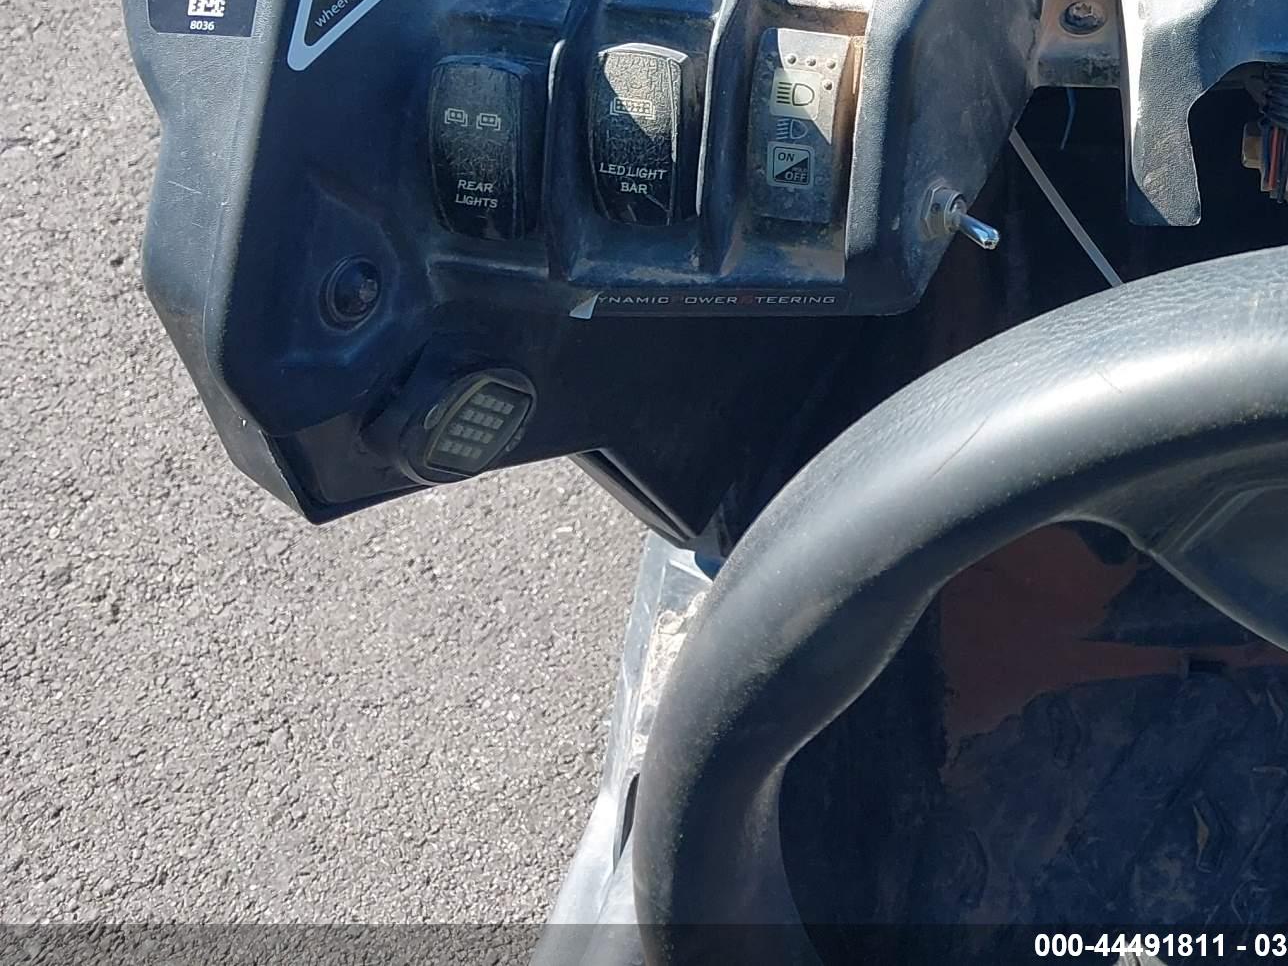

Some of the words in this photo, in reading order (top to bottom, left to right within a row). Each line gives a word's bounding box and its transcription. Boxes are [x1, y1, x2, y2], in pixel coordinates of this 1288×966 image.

[190, 20, 215, 31] 8036
[777, 152, 795, 162] ON
[599, 162, 626, 176] LED
[626, 166, 668, 180] LIGHT
[785, 171, 807, 183] OFF
[457, 179, 494, 193] REAR
[621, 182, 648, 195] BAR
[455, 194, 498, 209] LIGHTS
